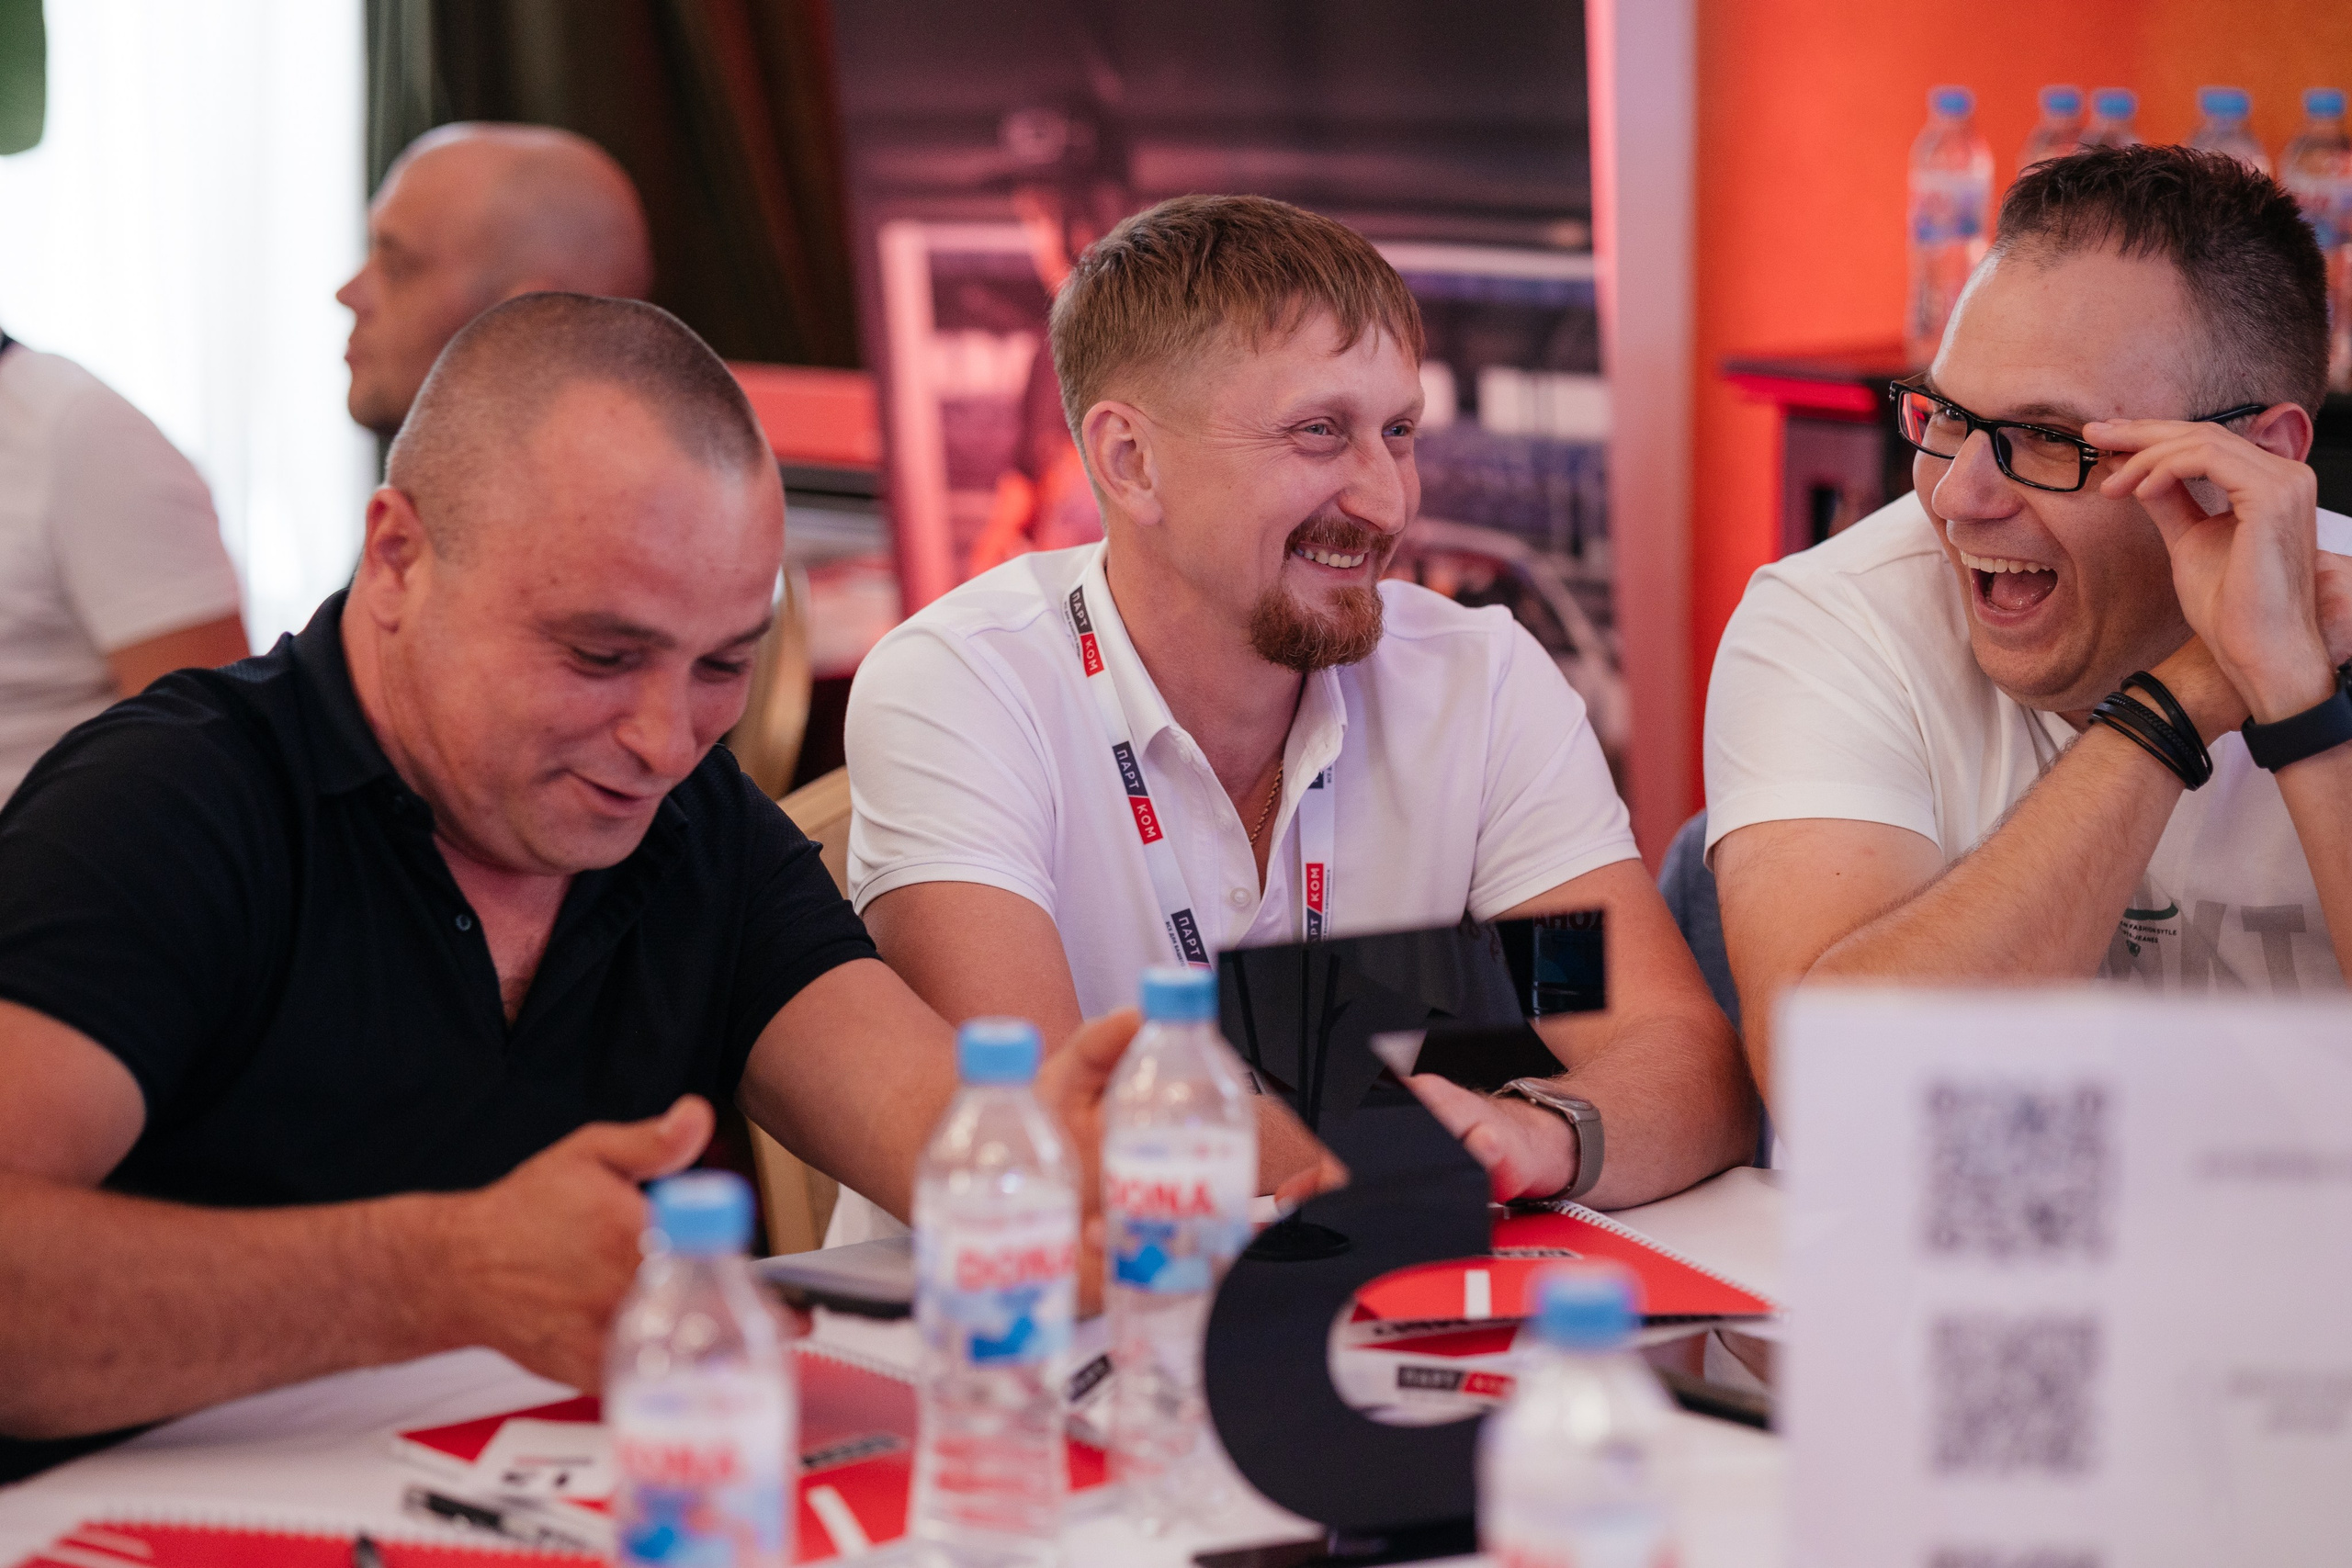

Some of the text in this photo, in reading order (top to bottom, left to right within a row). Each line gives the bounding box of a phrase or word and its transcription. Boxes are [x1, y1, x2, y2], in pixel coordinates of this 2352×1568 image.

[1071, 591, 1088, 627] ПАРТ
[1085, 639, 1099, 671] КОМ
[1116, 749, 1157, 838] ПАРТ КОМ
[1310, 867, 1320, 902] КОМ
[1179, 916, 1201, 955] ПАРТ
